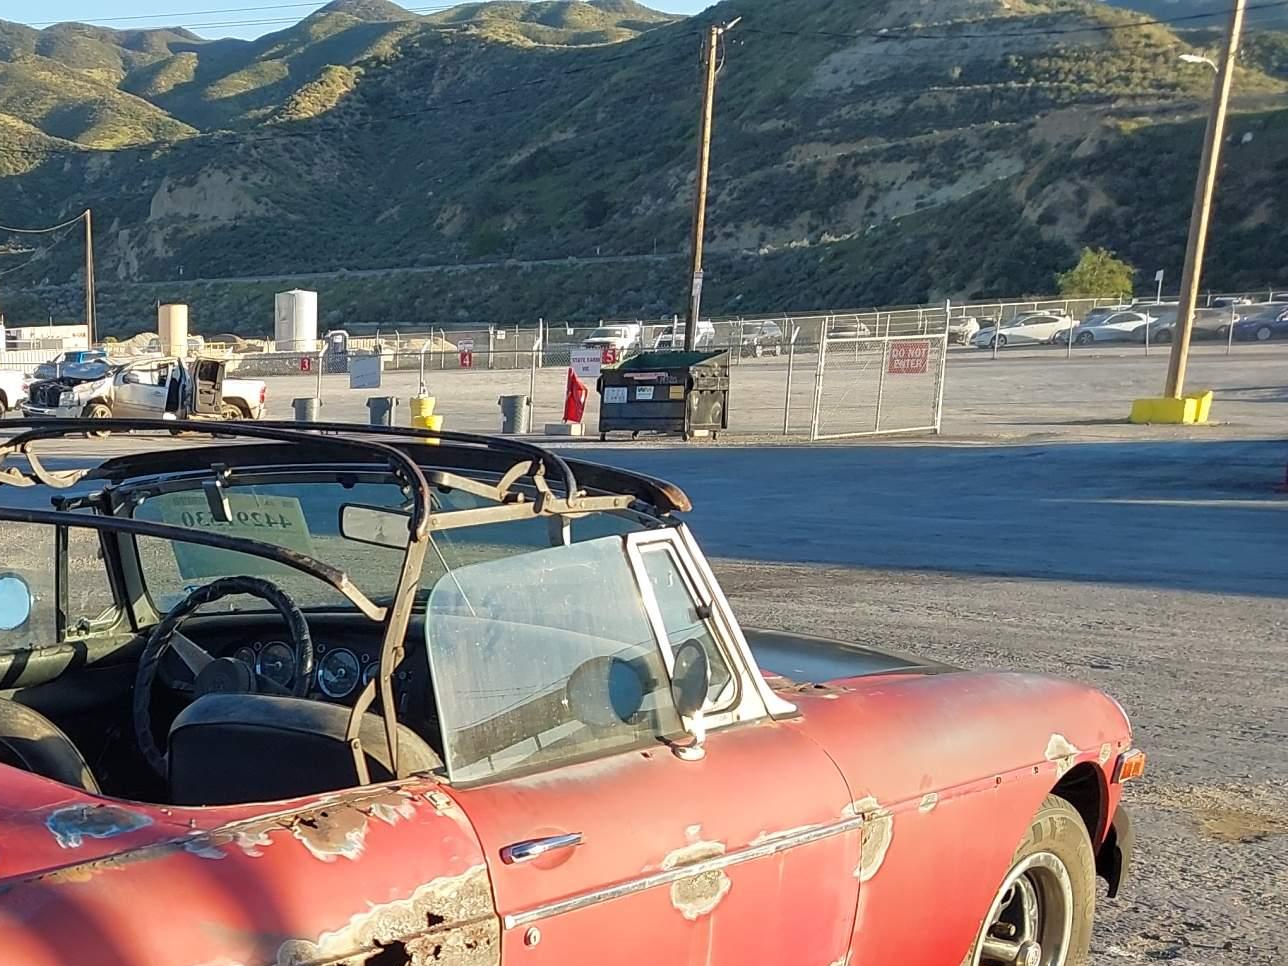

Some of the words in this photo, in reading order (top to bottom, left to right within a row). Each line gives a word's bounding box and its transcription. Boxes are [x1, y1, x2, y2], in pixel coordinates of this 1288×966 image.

[892, 349, 905, 358] DO
[907, 348, 927, 358] NOT
[894, 359, 923, 368] ENTER
